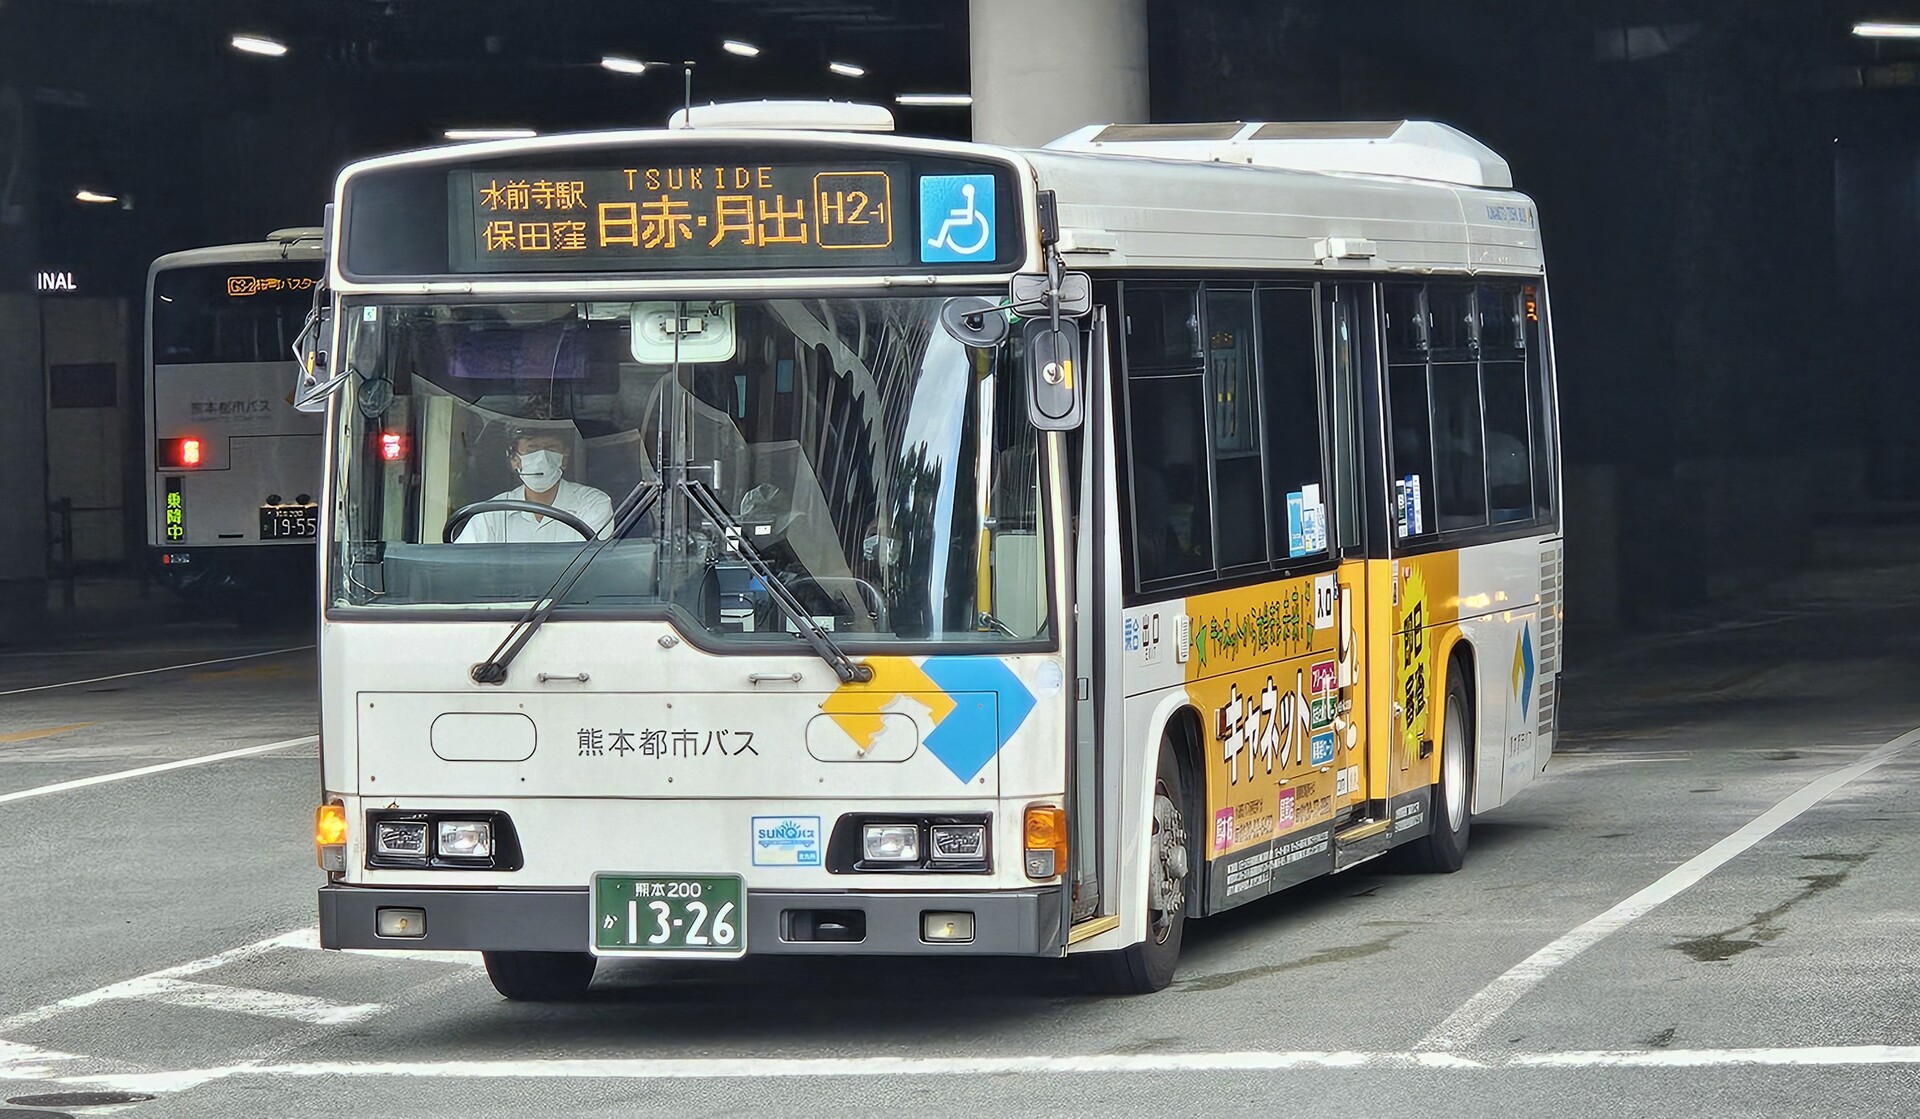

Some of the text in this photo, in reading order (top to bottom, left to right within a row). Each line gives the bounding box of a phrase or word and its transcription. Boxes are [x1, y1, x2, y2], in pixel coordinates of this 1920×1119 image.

[624, 167, 773, 190] TSUKIDE
[479, 180, 586, 211] 水前寺駅
[821, 191, 885, 226] H2-1
[482, 220, 587, 251] 保田窪
[598, 194, 808, 249] 日赤・月出
[38, 272, 77, 290] INAL
[273, 518, 316, 537] 19-55
[1316, 588, 1333, 619] 入口
[1142, 613, 1160, 648] 出口
[1223, 667, 1311, 786] キャネット
[576, 727, 760, 760] 熊本都市バス
[603, 900, 735, 945] か 13-26
